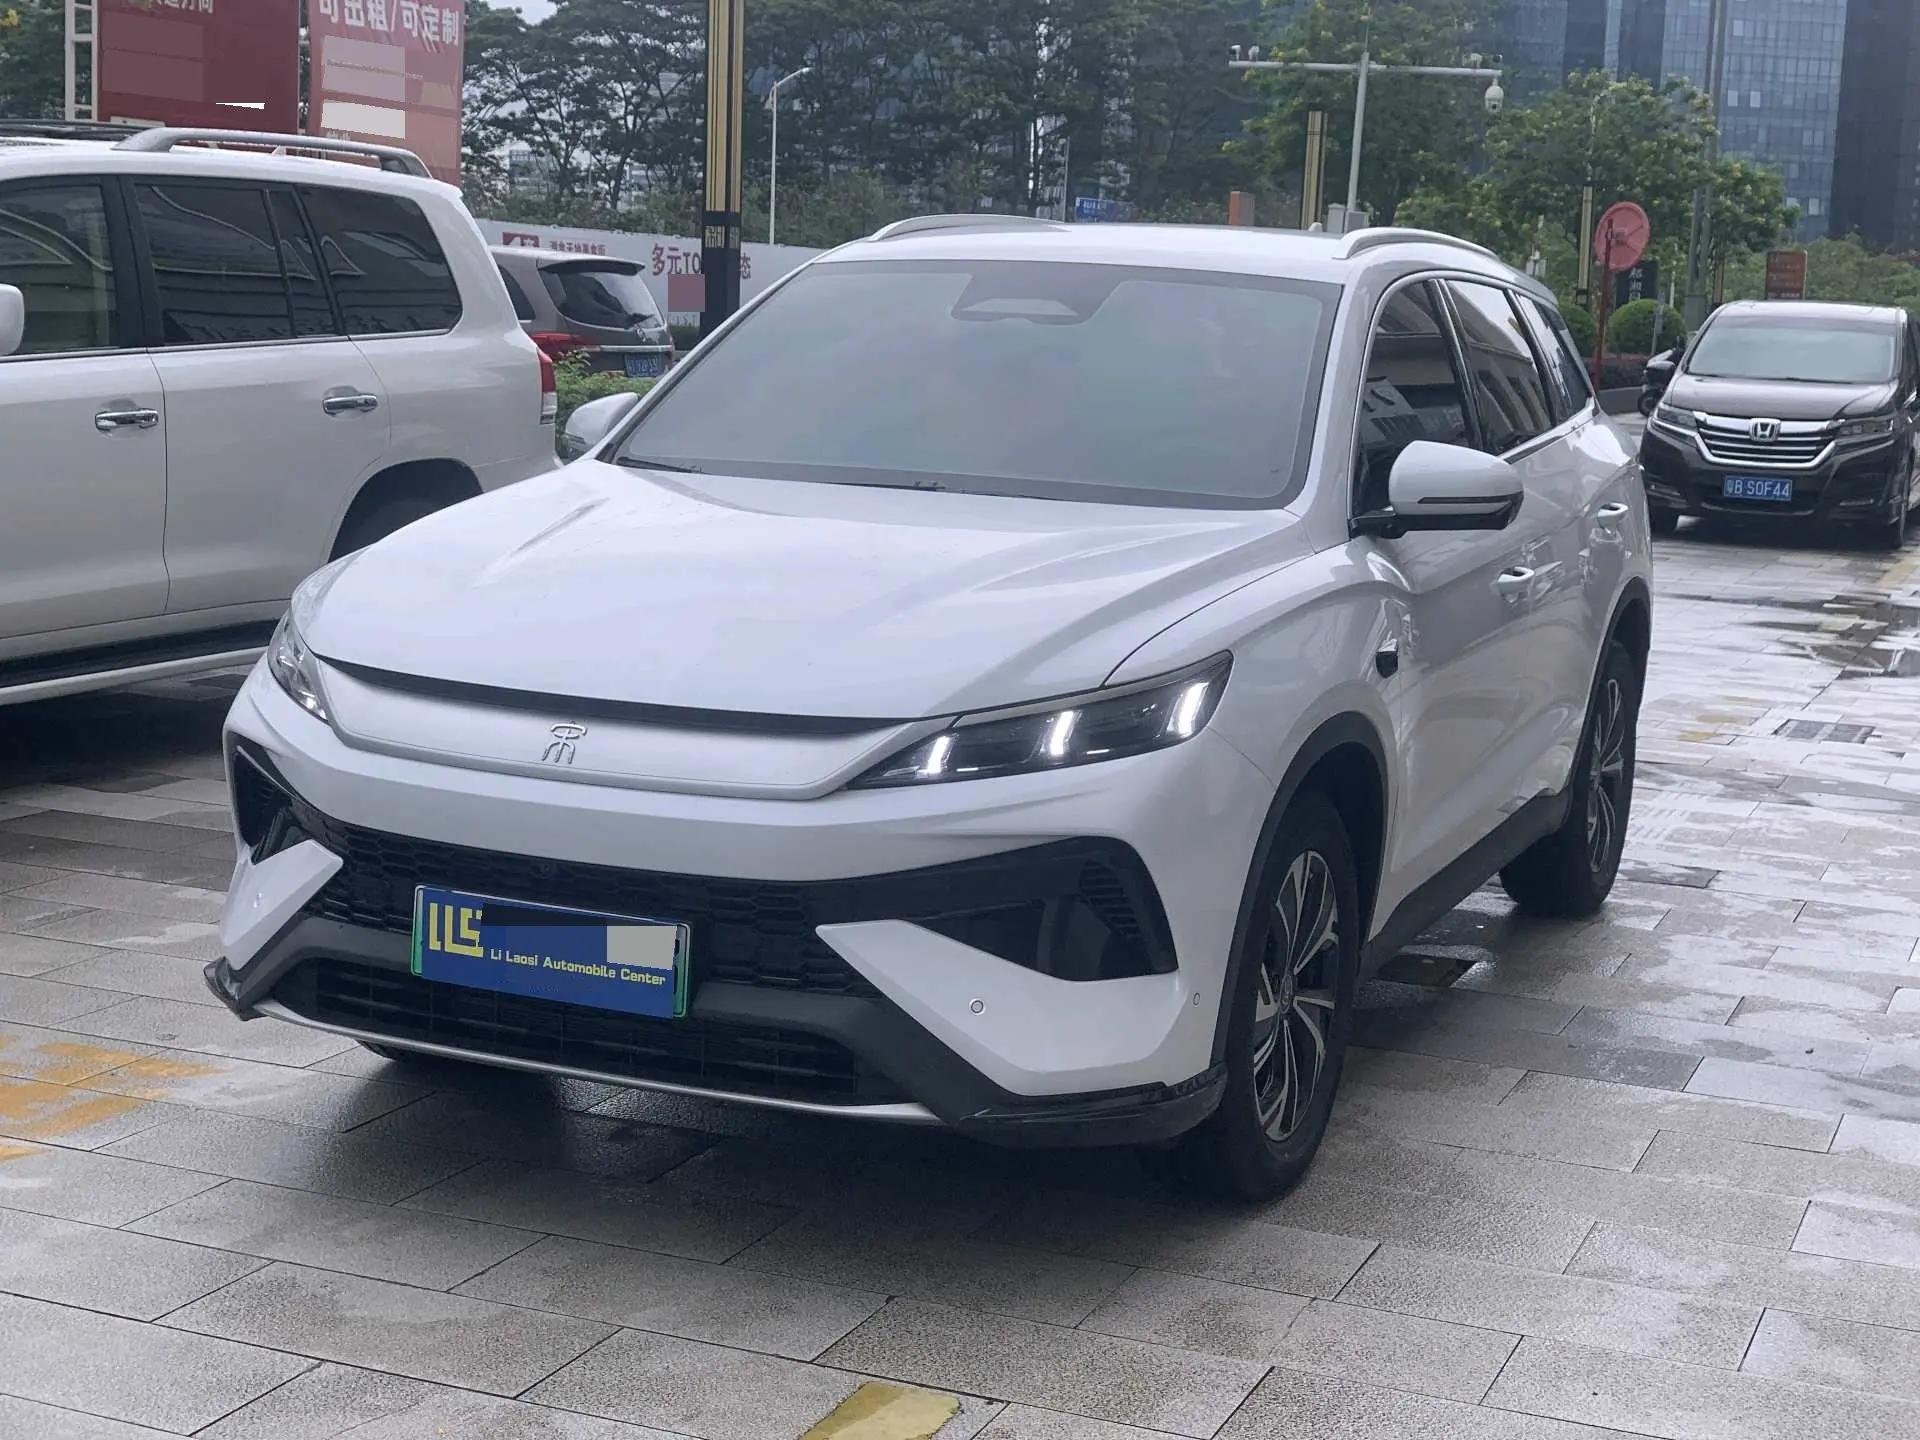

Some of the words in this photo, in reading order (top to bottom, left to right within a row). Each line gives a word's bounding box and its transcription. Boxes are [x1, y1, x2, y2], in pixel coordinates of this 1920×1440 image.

[490, 948, 502, 961] Li
[505, 950, 538, 966] Laosi
[543, 956, 616, 979] Automobile
[620, 968, 666, 985] Center
